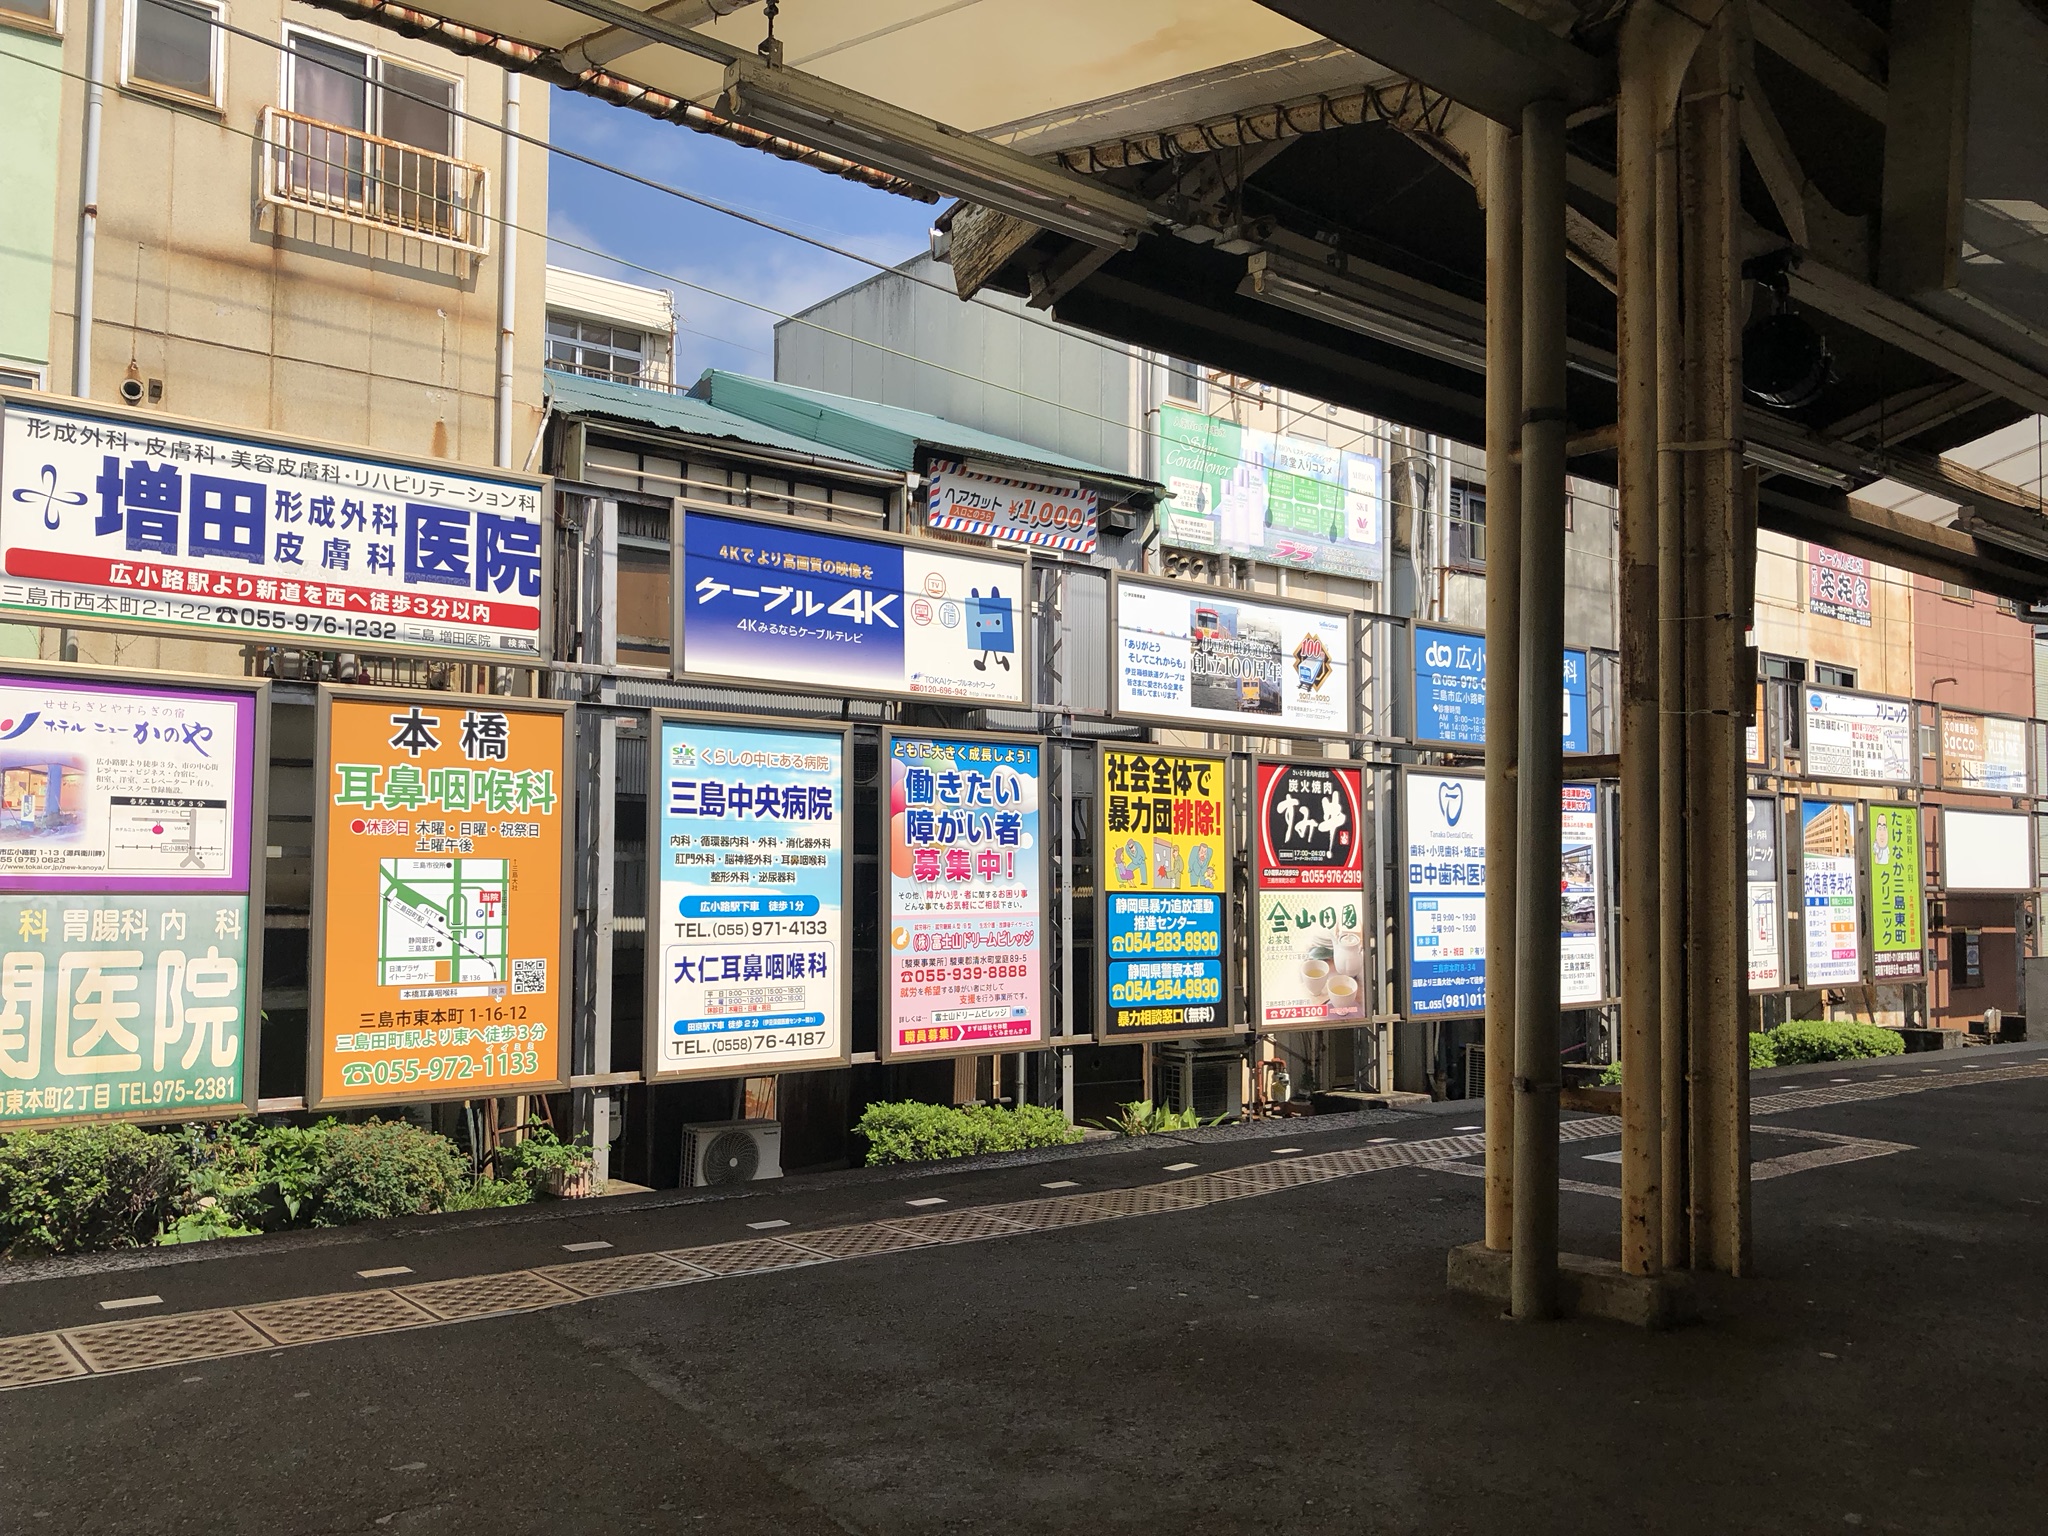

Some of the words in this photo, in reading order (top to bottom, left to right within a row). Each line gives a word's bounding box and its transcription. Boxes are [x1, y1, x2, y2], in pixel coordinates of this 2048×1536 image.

[27, 417, 536, 513] 形成外科・皮膚科・美容皮膚科・リハビリテーション科
[1166, 450, 1231, 477] Conditioner
[95, 455, 267, 565] 増田
[275, 490, 398, 537] 形成外科
[944, 488, 1002, 511] ヘアカット
[1008, 499, 1084, 529] ¥1,000
[273, 531, 396, 576] 皮膚科
[404, 502, 541, 597] 医院
[719, 545, 874, 580] 4Kでより高画質の映像を
[109, 563, 490, 622] 広小路駅より新道を西へ徒歩3分以内
[3, 584, 211, 621] 三島市西本町2-1-22
[240, 609, 397, 640] 055-976-1232
[439, 630, 491, 648] 増田医院
[736, 618, 863, 645] 4Kみるならケーブルテレビ
[1201, 637, 1273, 660] 伊豆箱根鉄道は
[1300, 639, 1322, 658] 100
[1191, 653, 1282, 683] 創立100周年
[919, 684, 967, 696] 0120-696-942
[44, 700, 185, 718] せせらぎとやすらぎの宿
[1439, 714, 1448, 722] AM
[389, 706, 510, 760] 本橋
[1439, 722, 1449, 730] PM
[44, 720, 86, 734] ホテル
[94, 722, 129, 734] ニュー
[133, 721, 214, 758] かのや
[1944, 731, 1975, 752] Sacco
[700, 748, 829, 771] くらしの中にある病院
[894, 743, 1031, 763] ともに大きく成長しよう!
[1108, 754, 1212, 797] 社会全体で
[335, 763, 557, 814] 耳鼻咽喉科
[905, 767, 1021, 806] 働きたい
[1288, 779, 1332, 794] 炭火焼肉
[670, 781, 832, 820] 三島中央病院
[1108, 795, 1221, 836] 暴力団排除!
[366, 820, 409, 835] 休診日
[416, 821, 540, 837] 木曜・日曜・祝祭日
[906, 809, 1022, 846] 障がい者
[416, 838, 473, 853] 土曜午後
[670, 836, 831, 849] 内科・循環器内科・外科・消化器外科
[1747, 846, 1773, 862] リニック
[412, 861, 446, 870] 三島市役所
[914, 849, 1014, 882] 募集中!
[710, 872, 796, 883] 整形外科・泌尿器科
[1891, 811, 1907, 945] たけなか三島東町
[481, 893, 500, 902] 当院
[898, 890, 1028, 899] その他、障がい児・者に関するお困り事
[904, 900, 1023, 910] どんな事でもお気軽にご相談下さい。
[393, 900, 426, 925] 三島田町駅
[424, 907, 439, 919] NTT
[700, 901, 760, 912] 広小路駅下車
[768, 900, 805, 912] 徒歩1分
[1115, 898, 1214, 914] 静岡県暴力追放運動
[1880, 871, 1892, 946] クリニック
[19, 909, 49, 943] 科
[62, 908, 149, 943] 胃腸科
[160, 908, 242, 942] 内科
[1133, 915, 1197, 931] 推進センター
[408, 937, 436, 945] 静岡銀行
[408, 944, 436, 952] 三島支店
[1125, 931, 1218, 952] 054-283-8930
[389, 972, 434, 981] イトーヨーカドー
[674, 952, 828, 984] 大仁耳鼻咽喉科
[915, 965, 1027, 983] 055-939-8888
[1127, 962, 1205, 980] 静岡県警察本部
[403, 989, 458, 998] 本橋耳鼻咽喉科
[900, 983, 1005, 998] 就労を希望する障がい者に対して
[959, 993, 1028, 1005] 支援を行う事業所です。
[1125, 978, 1219, 1002] 054-254-8930
[359, 1008, 464, 1029] 三島市東本町
[469, 1005, 527, 1023] 1-16-12
[934, 1007, 1007, 1022] 富士山ドリームビレッジ
[1117, 1006, 1215, 1027] 暴力相談窓口(無料)
[1280, 1007, 1323, 1018] 973-1500
[687, 1021, 725, 1031] 田京駅下車
[904, 1028, 954, 1044] 職員募集!
[336, 1022, 547, 1052] 三島田町駅より東へ徒歩3分
[373, 1050, 539, 1084] 055-972-1133
[0, 1083, 111, 1116] 東本町2丁目
